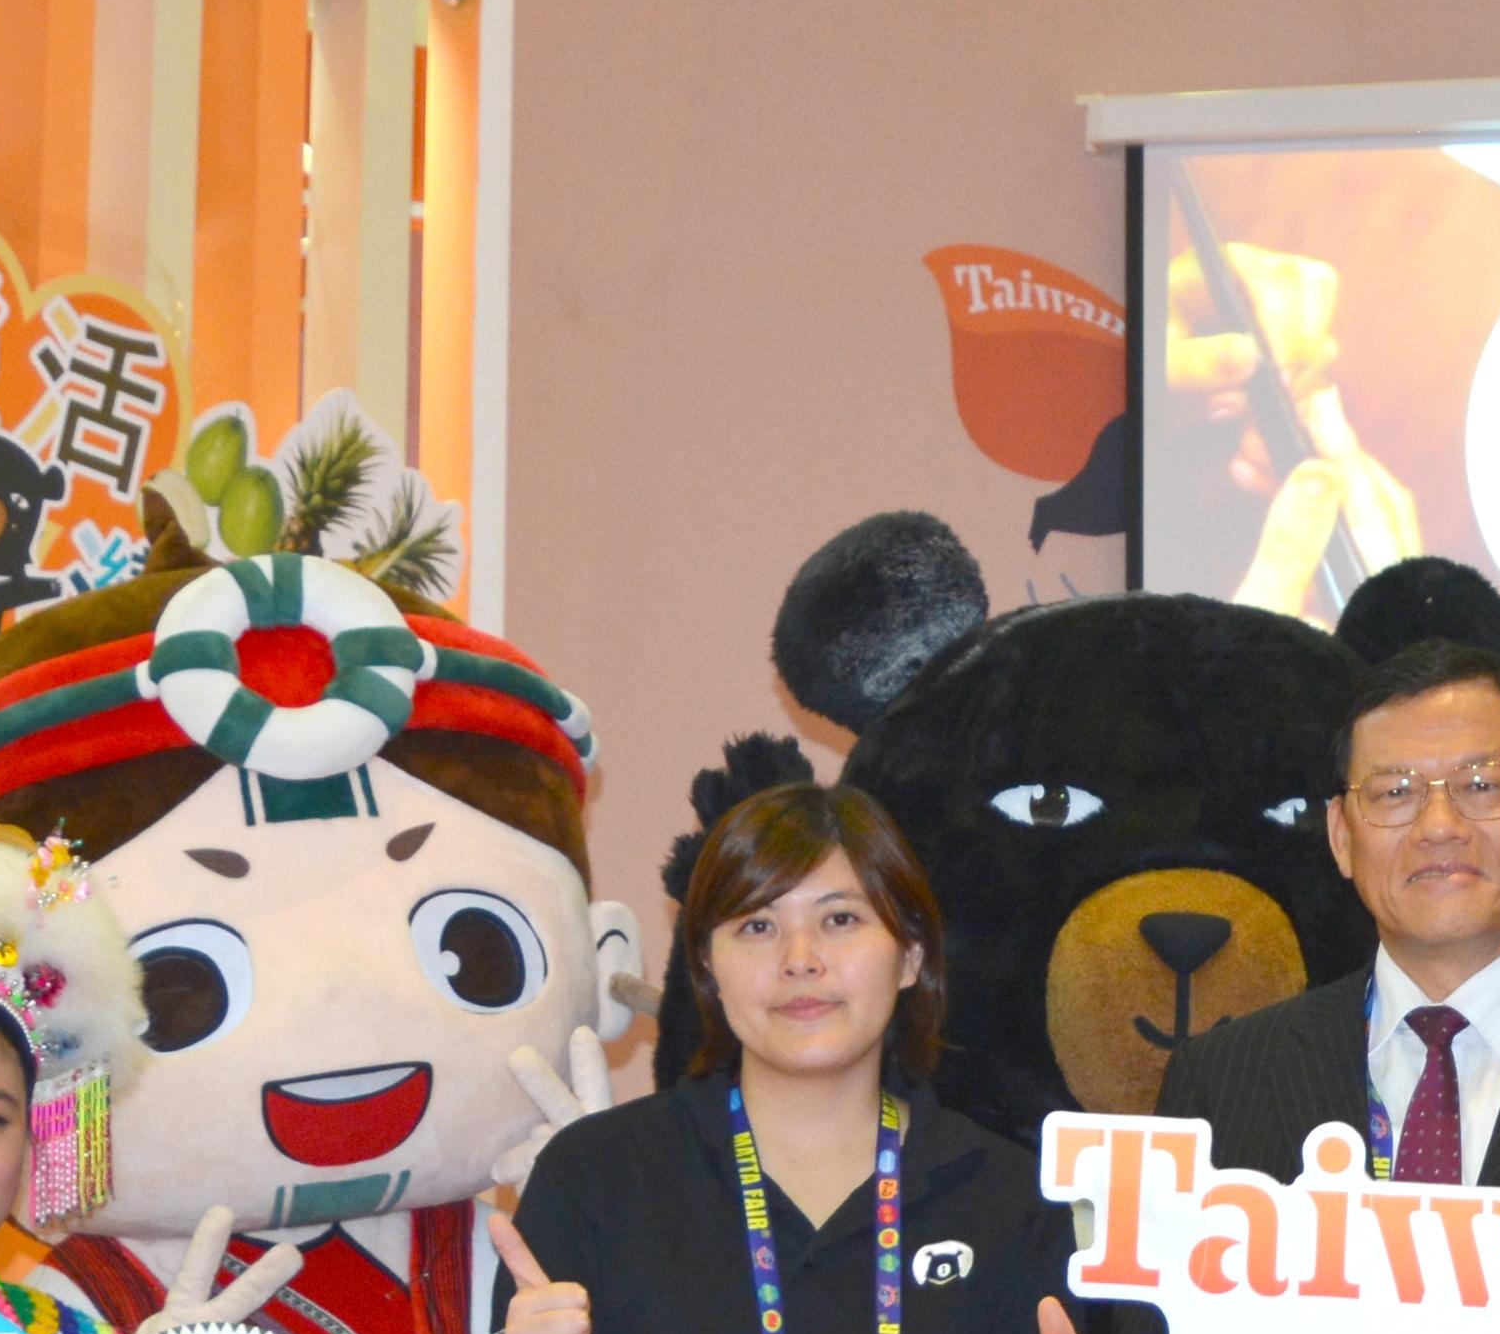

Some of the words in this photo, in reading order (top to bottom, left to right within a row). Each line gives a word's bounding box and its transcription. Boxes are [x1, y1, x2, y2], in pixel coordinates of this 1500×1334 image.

[953, 264, 1126, 338] Taiwan
[733, 1131, 761, 1185] MATTA
[743, 1188, 770, 1231] FAIR
